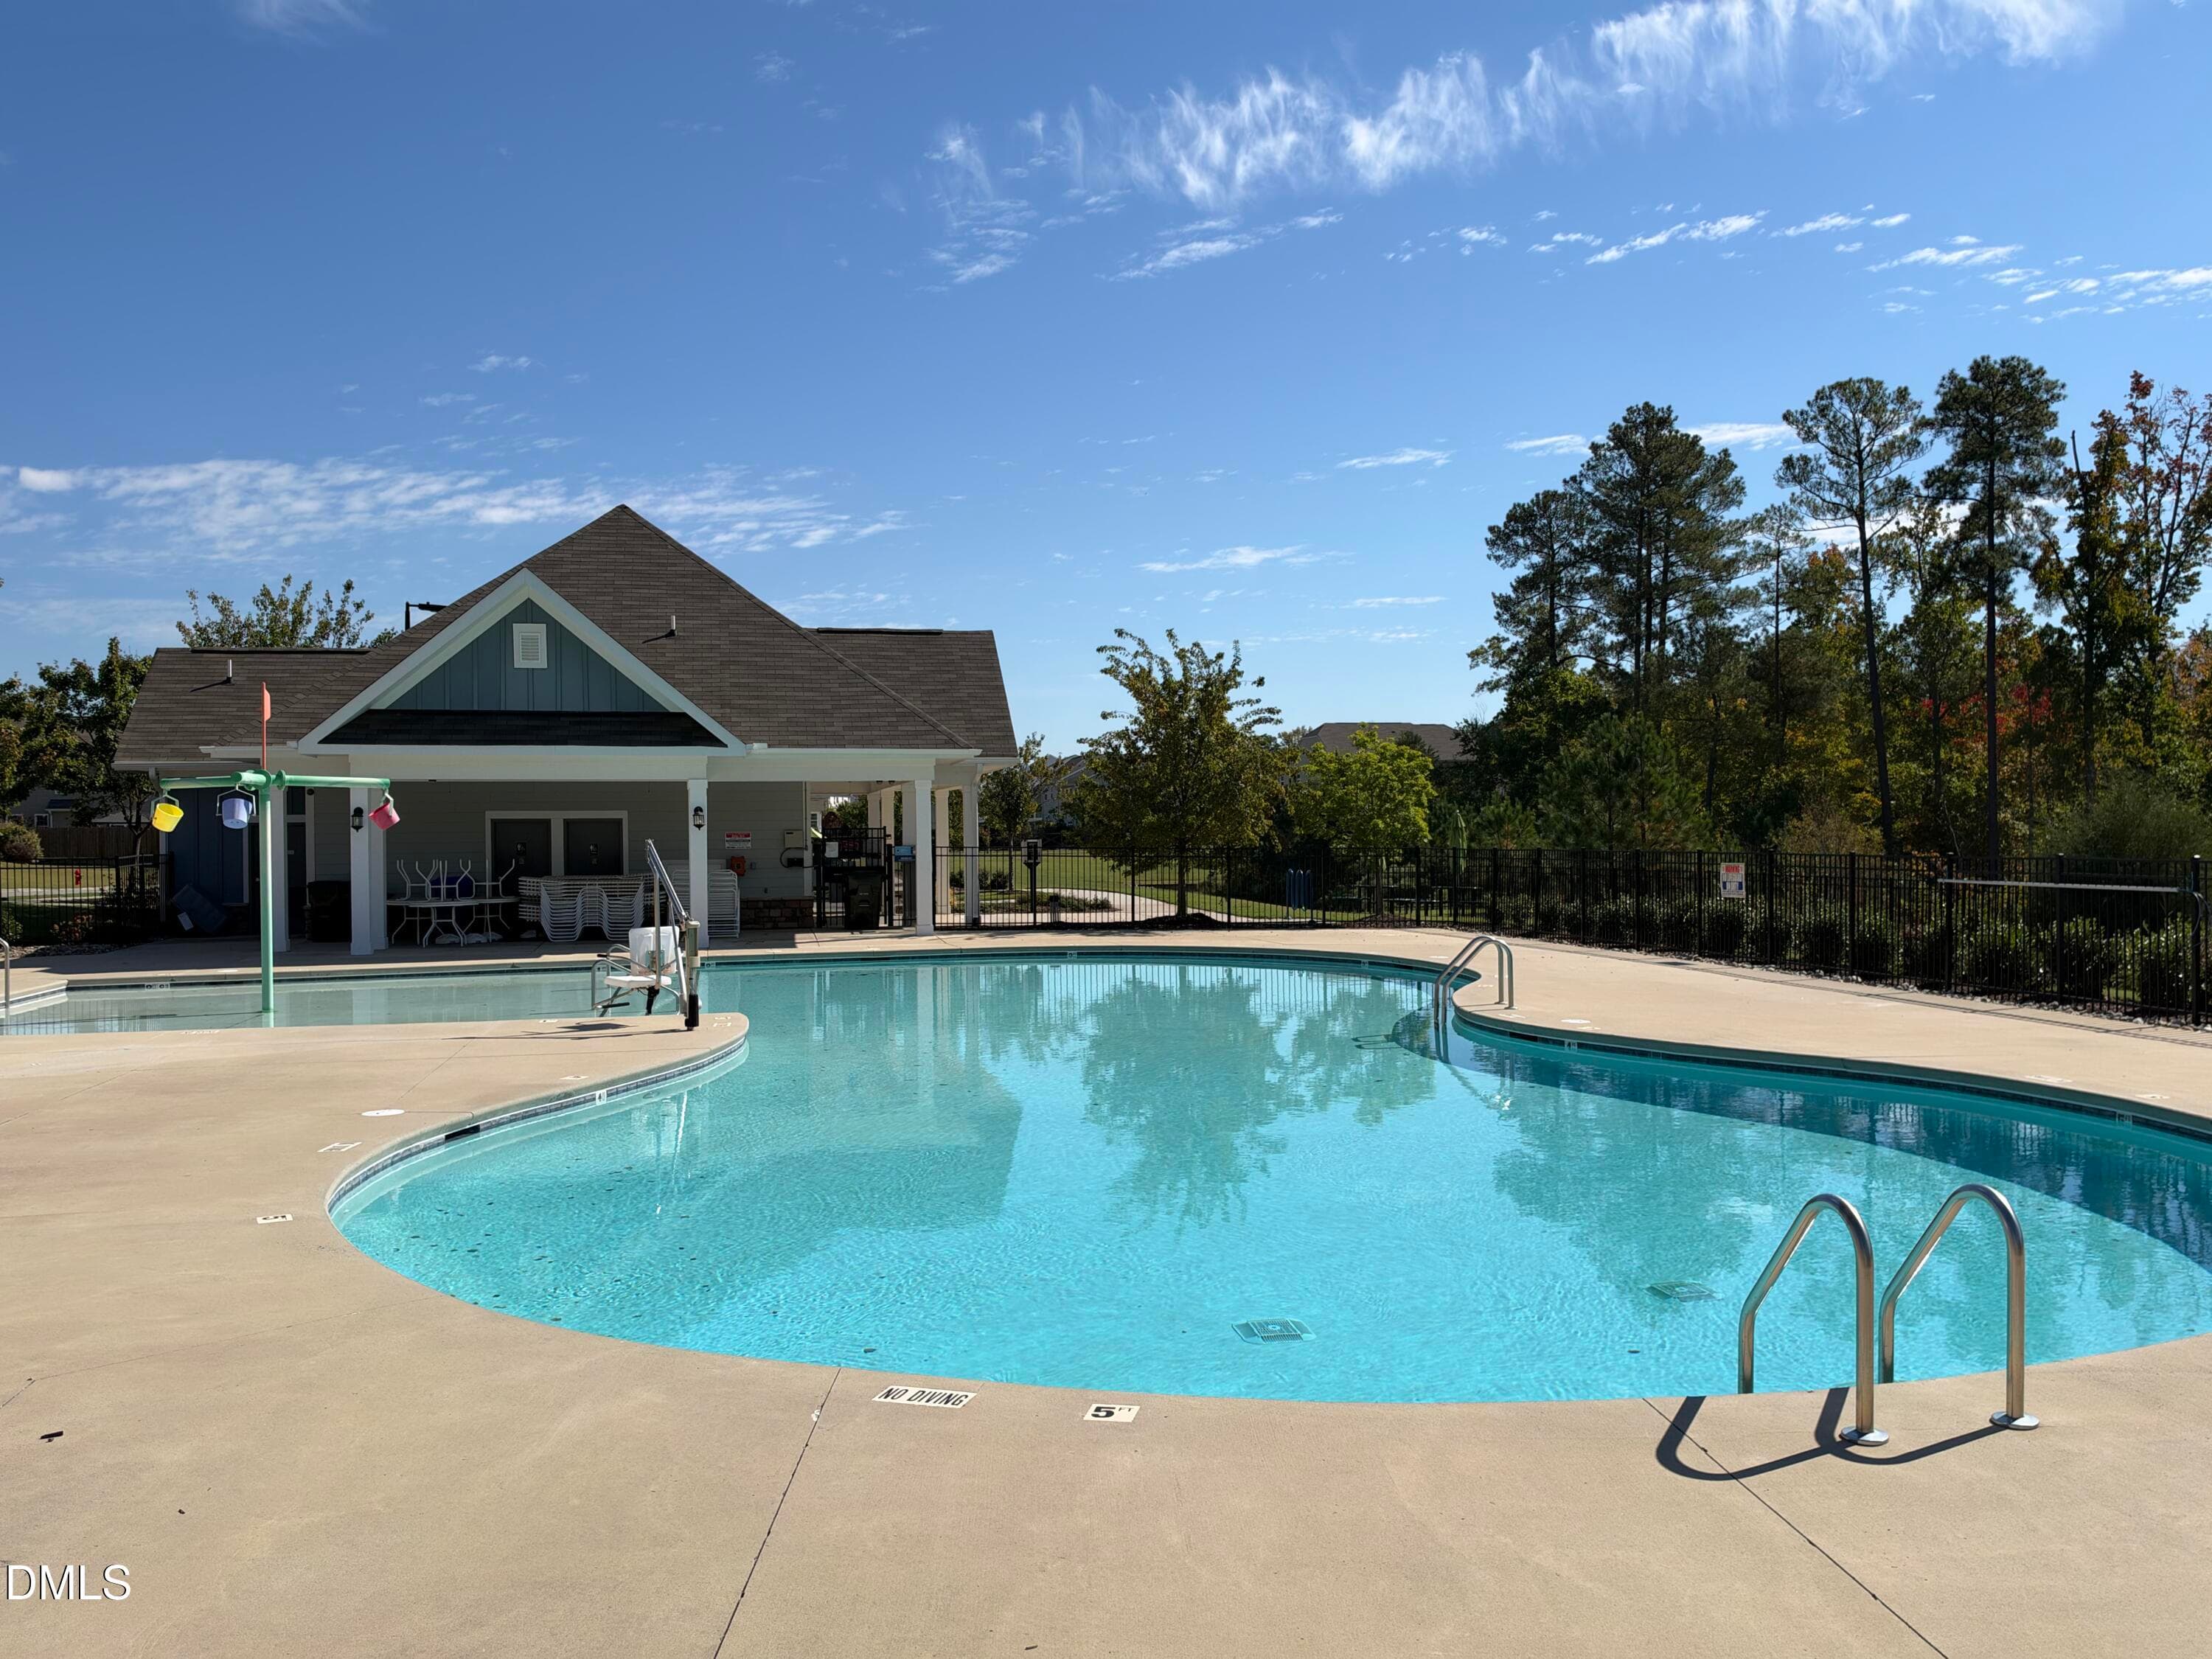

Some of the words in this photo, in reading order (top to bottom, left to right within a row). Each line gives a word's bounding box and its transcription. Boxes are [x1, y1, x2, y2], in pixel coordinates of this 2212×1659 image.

[878, 1388, 908, 1399] NO
[907, 1390, 968, 1406] DIVING
[1091, 1406, 1116, 1418] 5
